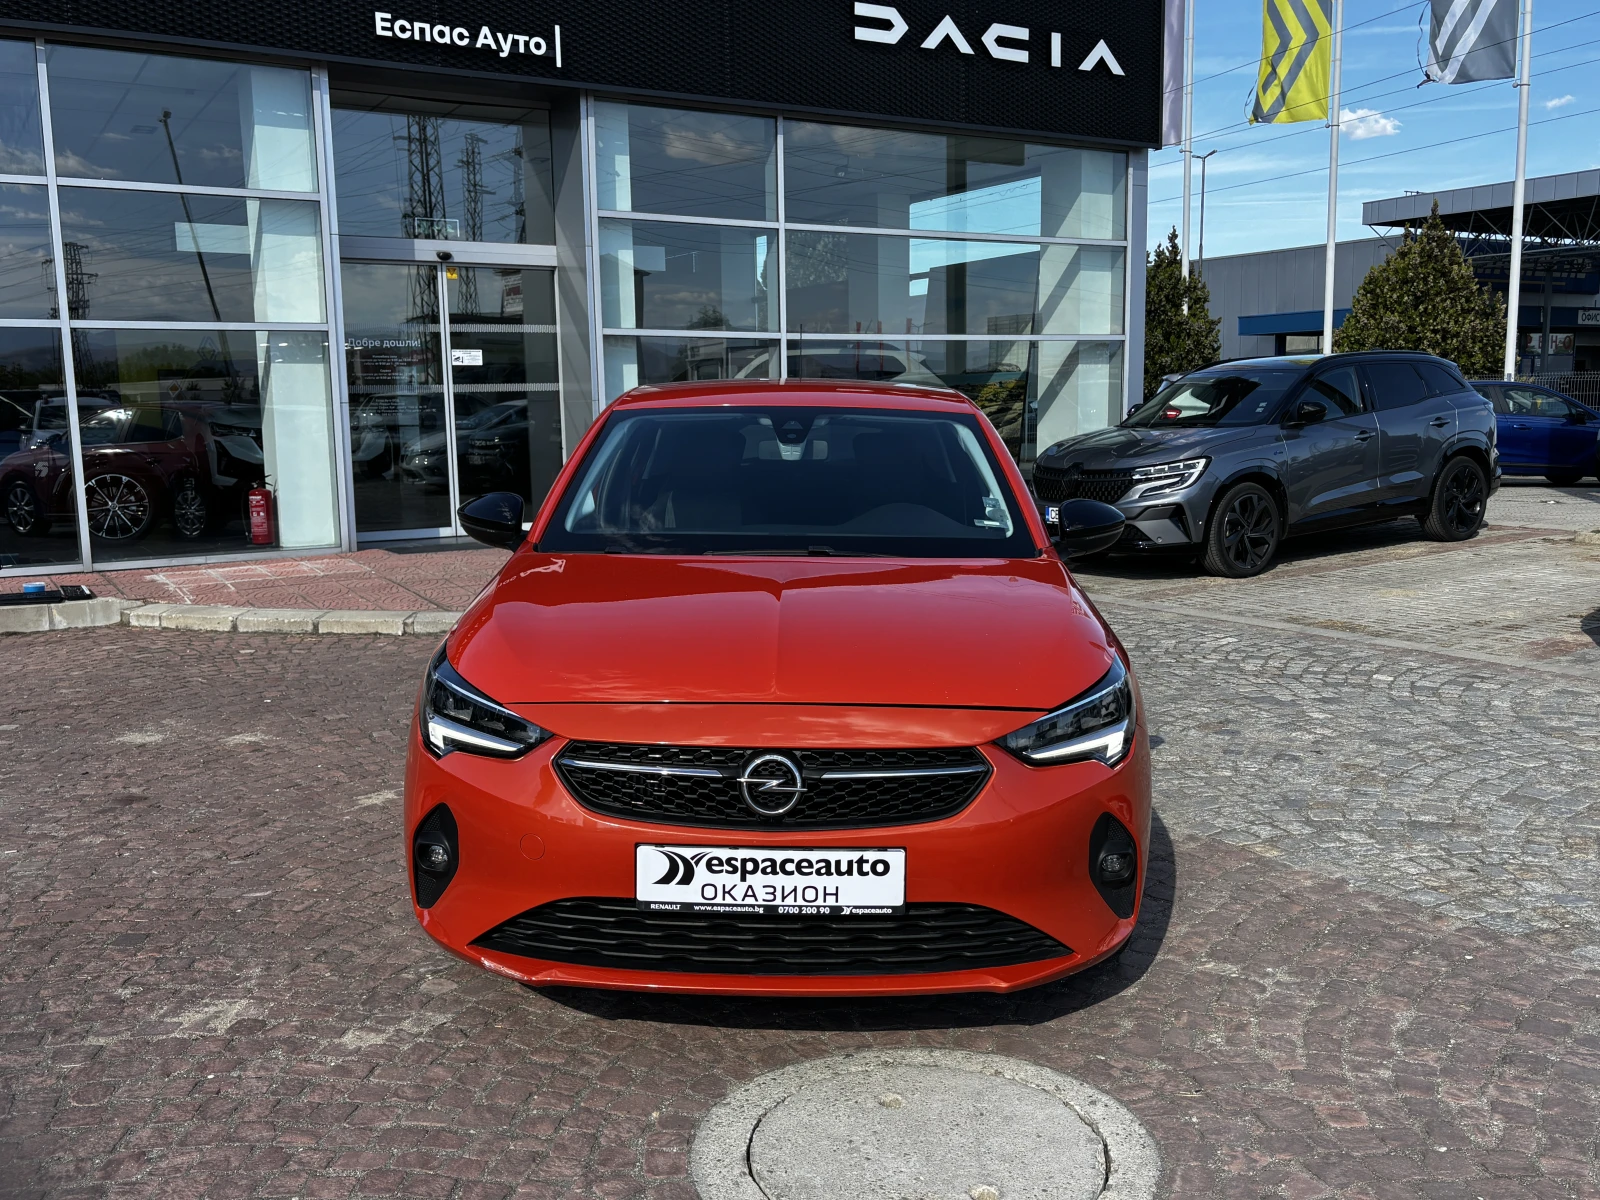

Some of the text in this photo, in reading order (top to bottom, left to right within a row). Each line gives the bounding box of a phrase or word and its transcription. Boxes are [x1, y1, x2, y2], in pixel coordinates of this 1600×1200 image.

[374, 11, 547, 58] Еспас Ауто
[854, 1, 1126, 76] DACIA
[348, 338, 421, 348] Добре дошли!
[705, 853, 891, 882] espaceauto
[700, 883, 839, 903] ОКАЗИОН
[693, 904, 764, 914] www.espaceauto.bg
[778, 906, 799, 914] 0700
[851, 907, 892, 915] espaceauto
